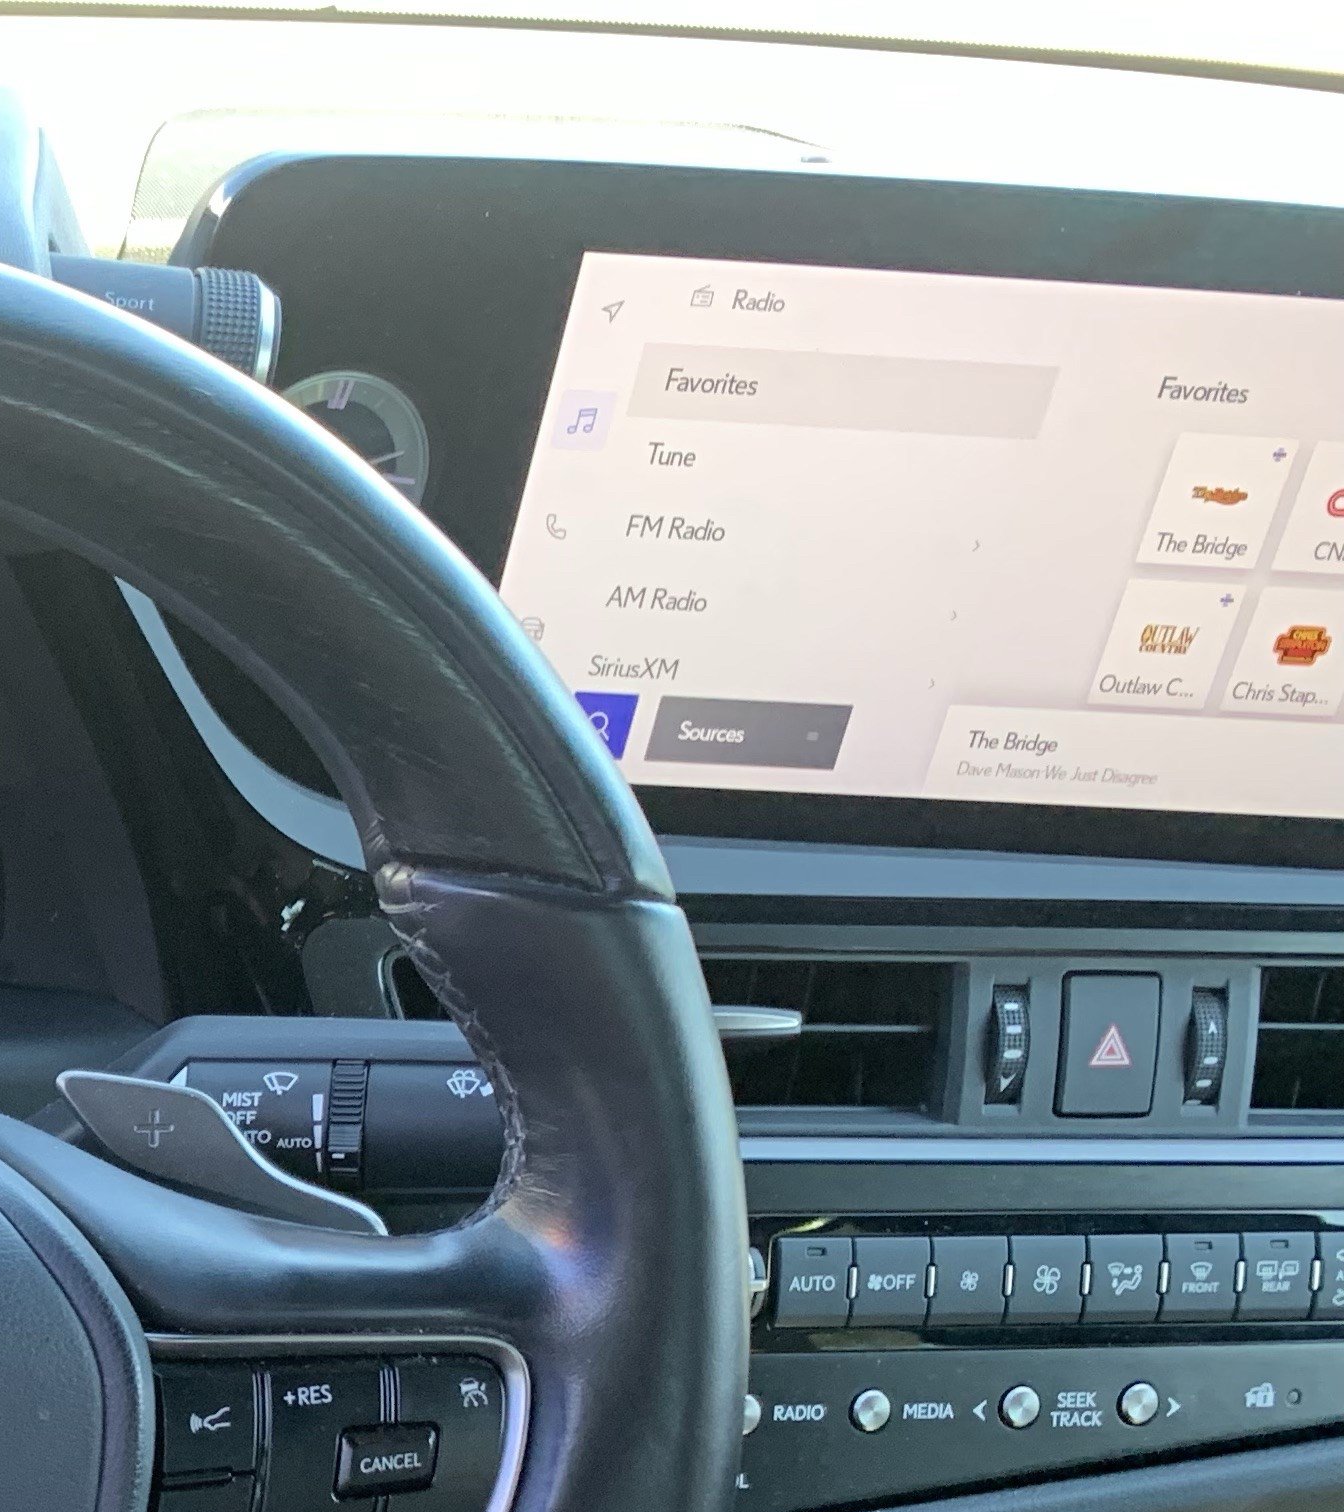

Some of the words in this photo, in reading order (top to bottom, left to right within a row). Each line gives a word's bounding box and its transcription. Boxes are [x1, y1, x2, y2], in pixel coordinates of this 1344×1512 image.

[105, 291, 154, 311] Sport
[731, 289, 786, 312] Radio
[665, 367, 759, 396] Favorites
[1157, 375, 1250, 404] Favorites
[648, 441, 697, 467] Tune
[625, 514, 664, 539] FM
[668, 516, 726, 541] Radio
[1157, 532, 1187, 553] The
[1192, 534, 1248, 560] Bridge
[605, 585, 647, 609] AM
[650, 588, 708, 612] Radio
[587, 654, 680, 680] SiriusXM
[1099, 674, 1162, 695] Outlaw
[1232, 681, 1275, 702] Chris
[678, 720, 745, 743] Sources
[969, 730, 999, 750] The
[1003, 732, 1058, 756] Bridge
[956, 761, 992, 777] Dave
[1070, 766, 1099, 783] Just
[222, 1092, 262, 1107] MIST
[276, 1137, 312, 1149] AUTO
[789, 1275, 836, 1293] AUTO
[882, 1274, 915, 1291] OFF
[1181, 1282, 1220, 1294] FRONT
[1262, 1281, 1291, 1293] REAR
[1057, 1391, 1097, 1408] SEEK
[773, 1403, 825, 1422] RADIO
[903, 1403, 954, 1421] MEDIA
[1050, 1410, 1103, 1428] TRACK
[360, 1452, 422, 1474] CANCEL
